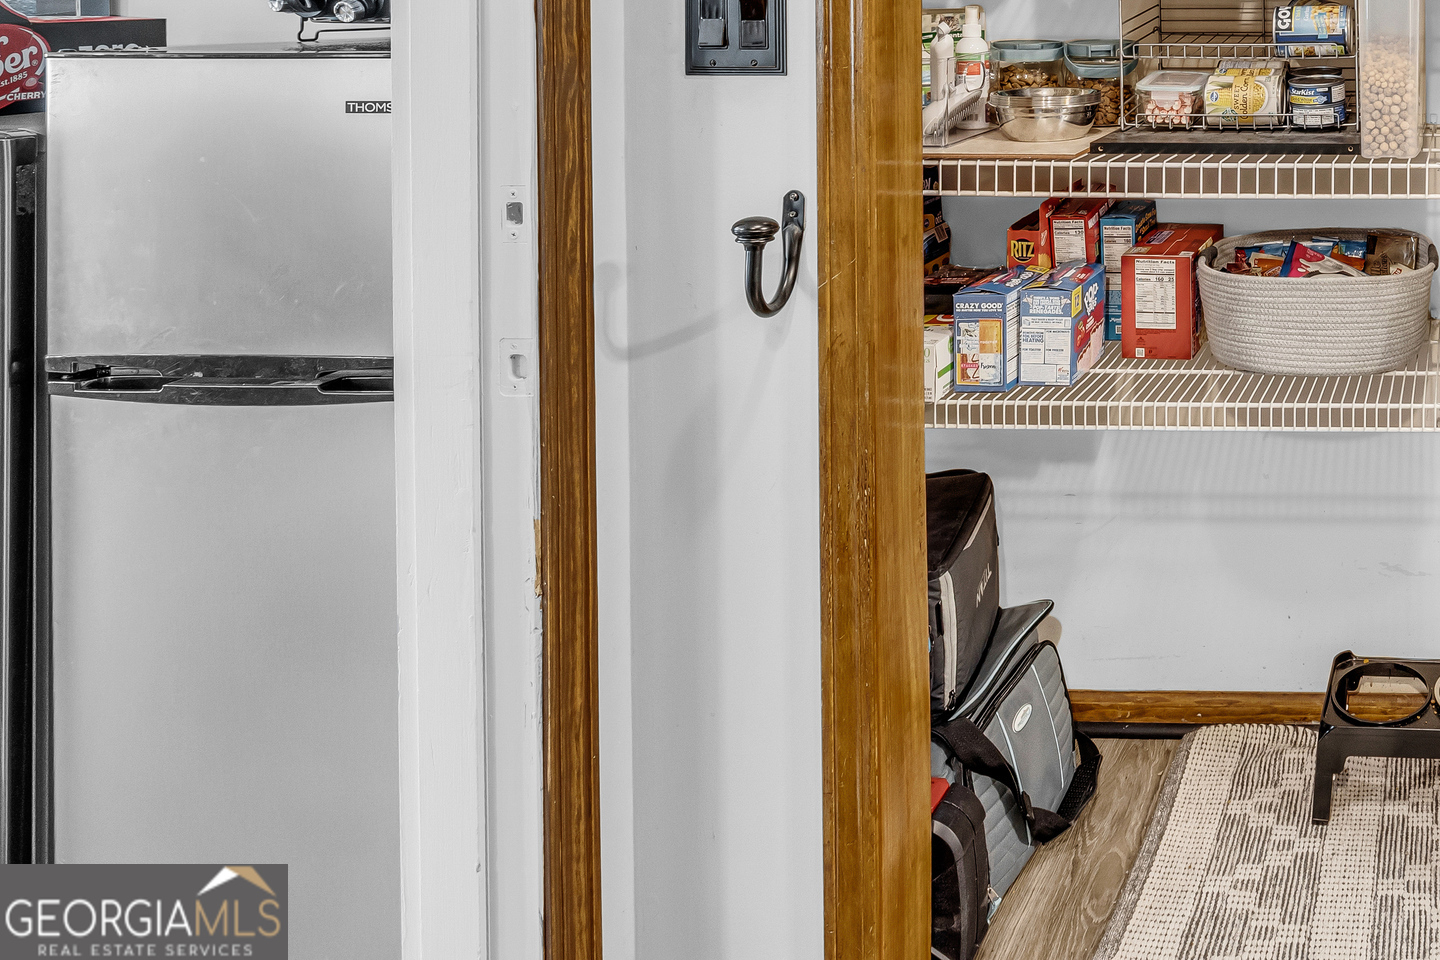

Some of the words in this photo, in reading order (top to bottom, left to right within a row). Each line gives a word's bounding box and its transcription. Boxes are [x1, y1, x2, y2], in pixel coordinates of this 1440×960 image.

[1240, 76, 1250, 92] Corn
[1291, 87, 1315, 96] StarKist
[1233, 84, 1241, 110] SWEET
[1010, 240, 1035, 258] RITZ
